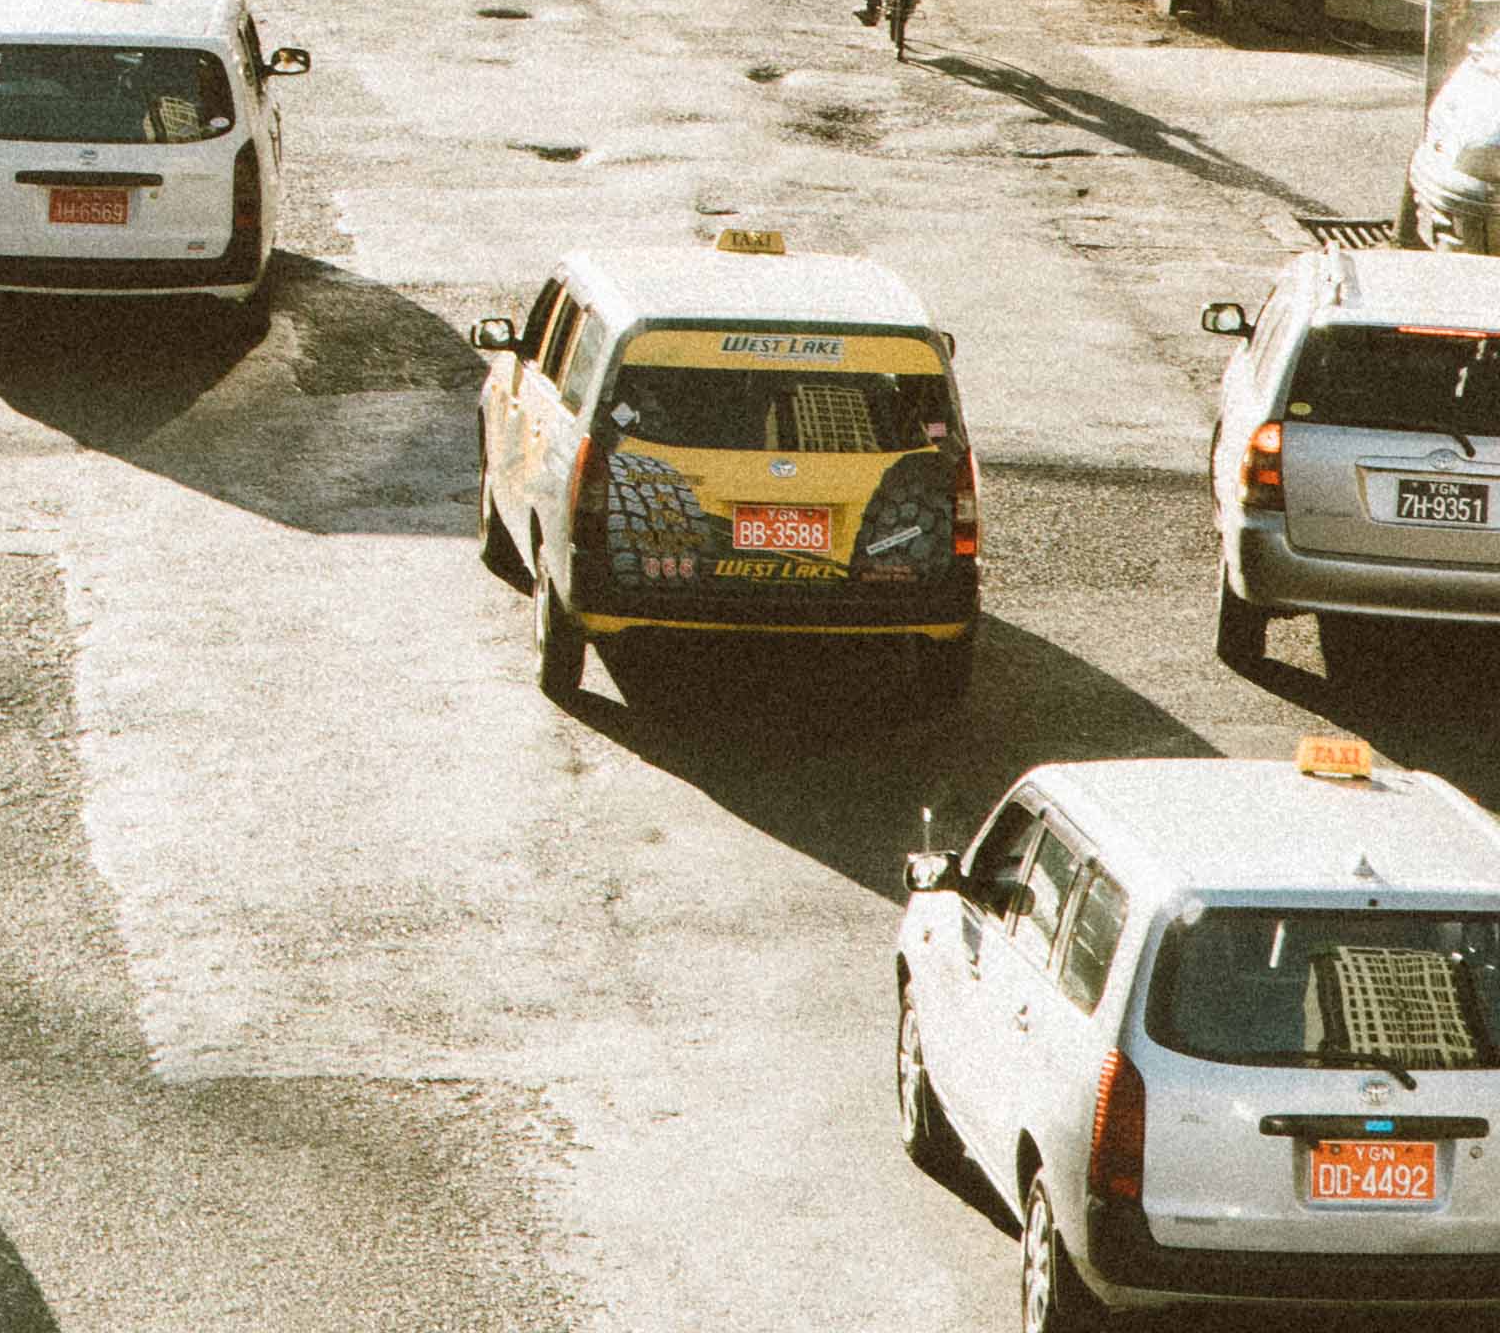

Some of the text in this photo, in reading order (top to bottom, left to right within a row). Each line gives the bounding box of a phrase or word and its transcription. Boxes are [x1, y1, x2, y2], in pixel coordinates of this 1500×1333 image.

[730, 232, 772, 247] TAXI
[1428, 484, 1460, 496] YGN
[767, 510, 799, 521] YGN
[1401, 493, 1484, 525] 7H-9351
[739, 522, 825, 548] BB-3588
[1315, 746, 1362, 765] TAXI
[1355, 1145, 1396, 1161] YGN
[1318, 1161, 1429, 1197] DD-4492
